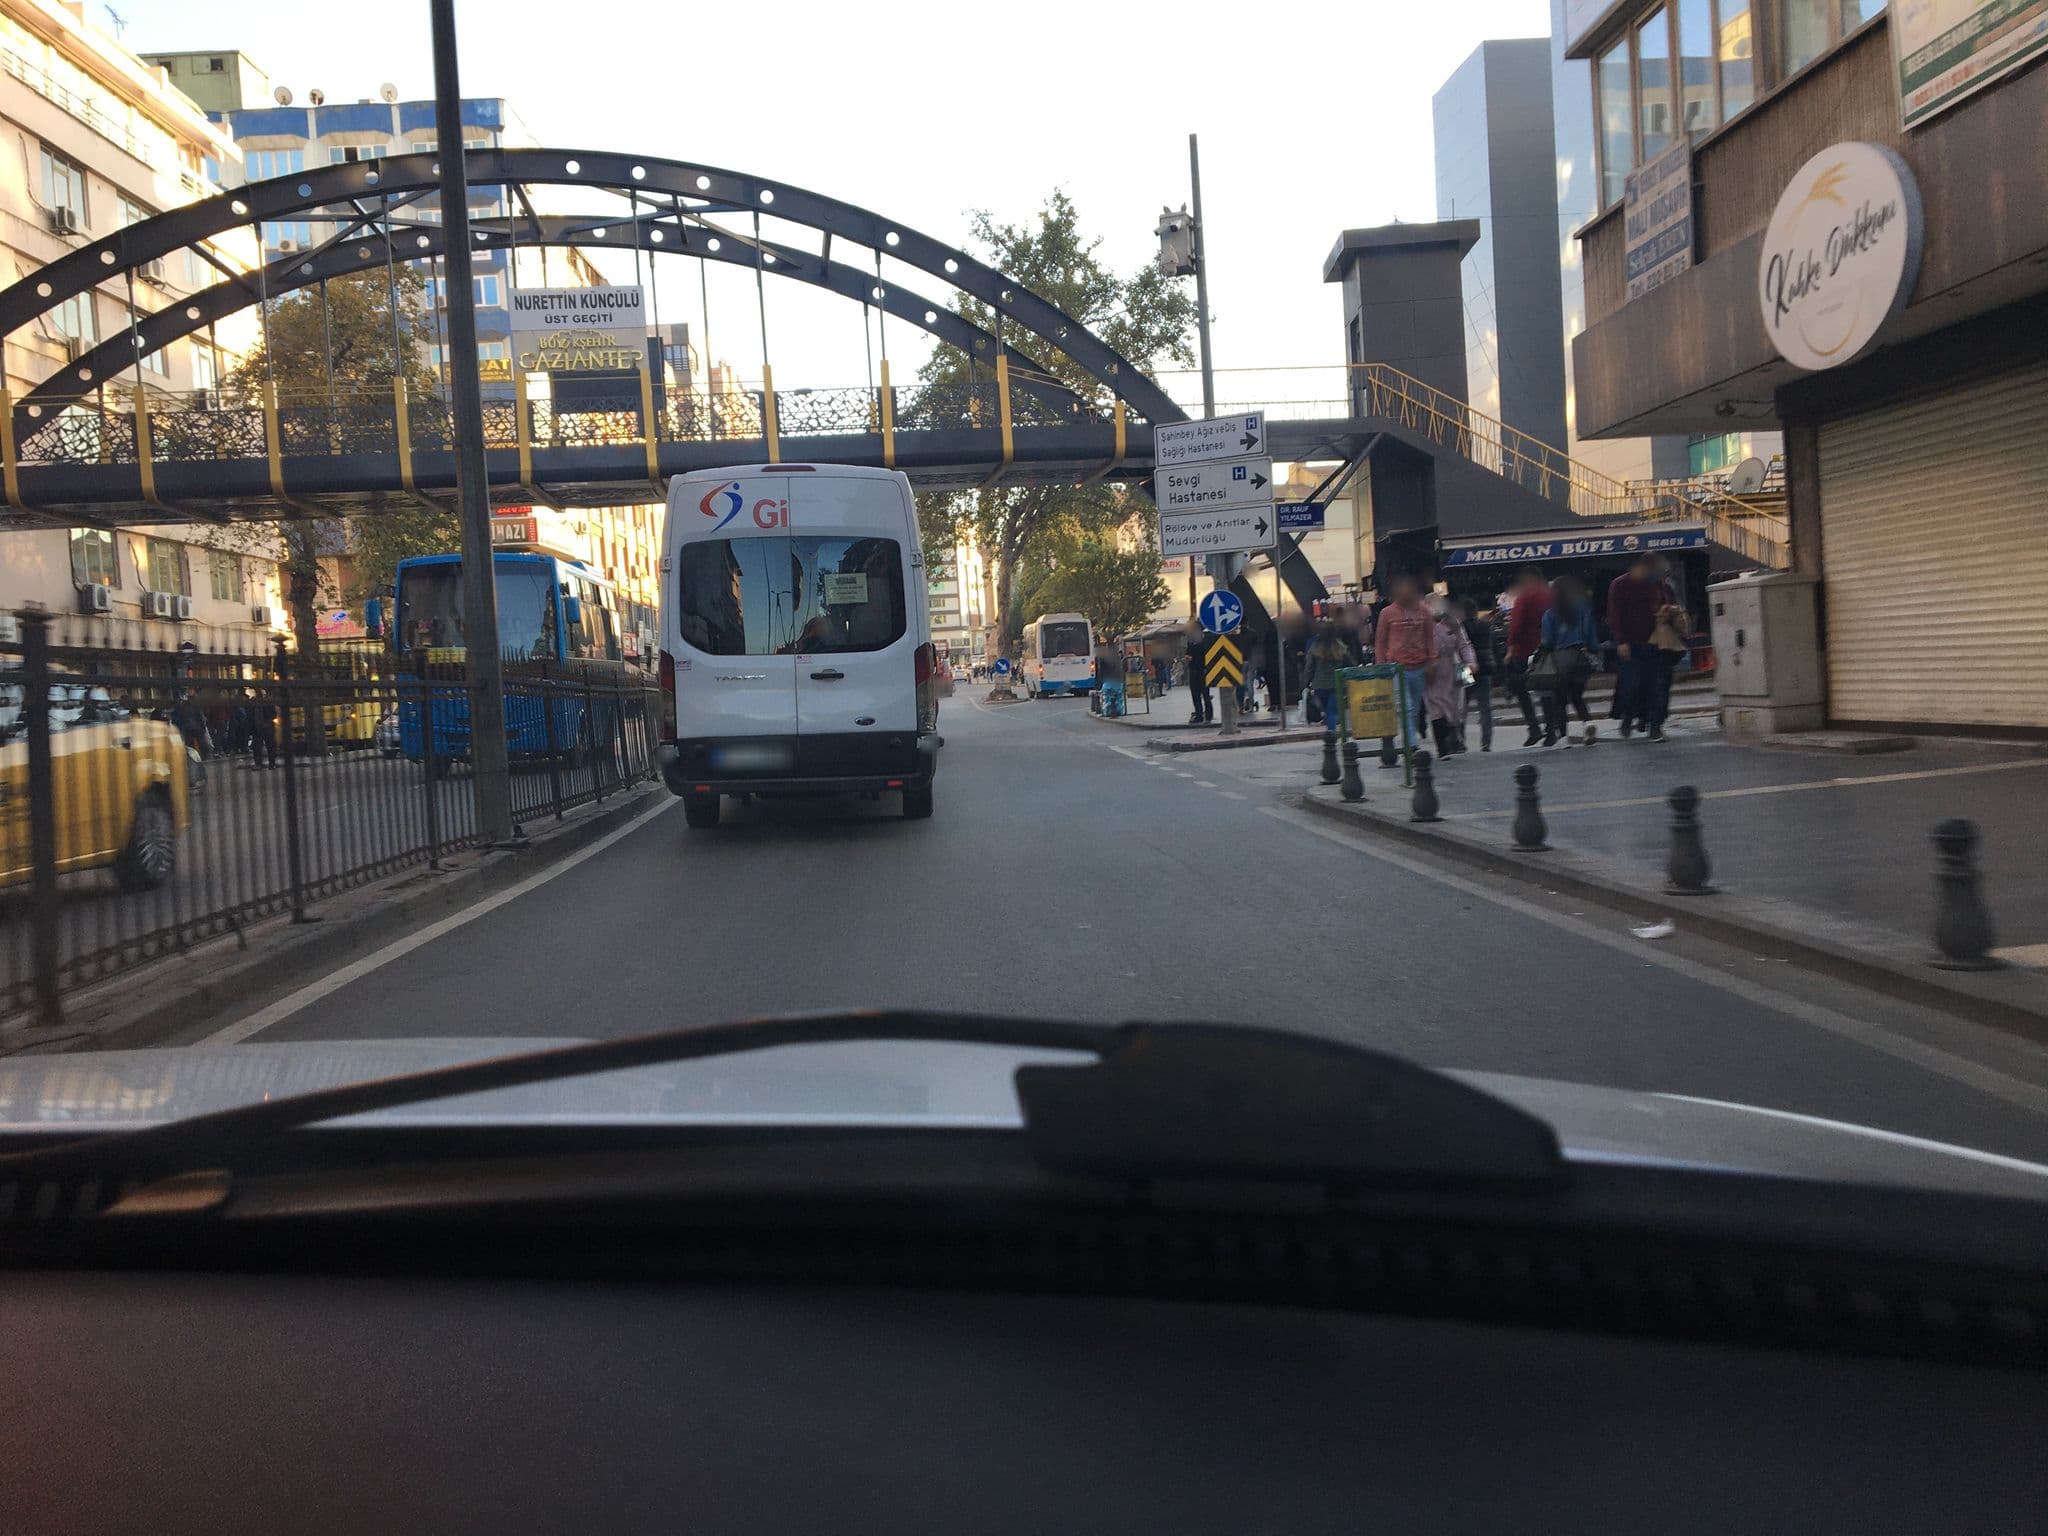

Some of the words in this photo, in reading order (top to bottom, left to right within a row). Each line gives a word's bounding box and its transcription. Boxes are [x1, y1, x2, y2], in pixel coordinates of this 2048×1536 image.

[514, 290, 577, 311] NURETTİN
[580, 289, 640, 309] KÜNCÜLÜ
[544, 314, 569, 324] ÜST
[572, 312, 613, 325] GEÇİTİ
[1188, 441, 1226, 454] Hastanesi
[1168, 473, 1200, 487] Sevgi
[1169, 488, 1226, 504] Hastanesi
[753, 498, 788, 529] Gi
[1201, 522, 1212, 530] ve
[1216, 518, 1250, 528] Anıtlar
[1465, 544, 1552, 562] MERCAN
[1561, 538, 1615, 555] BÜFE
